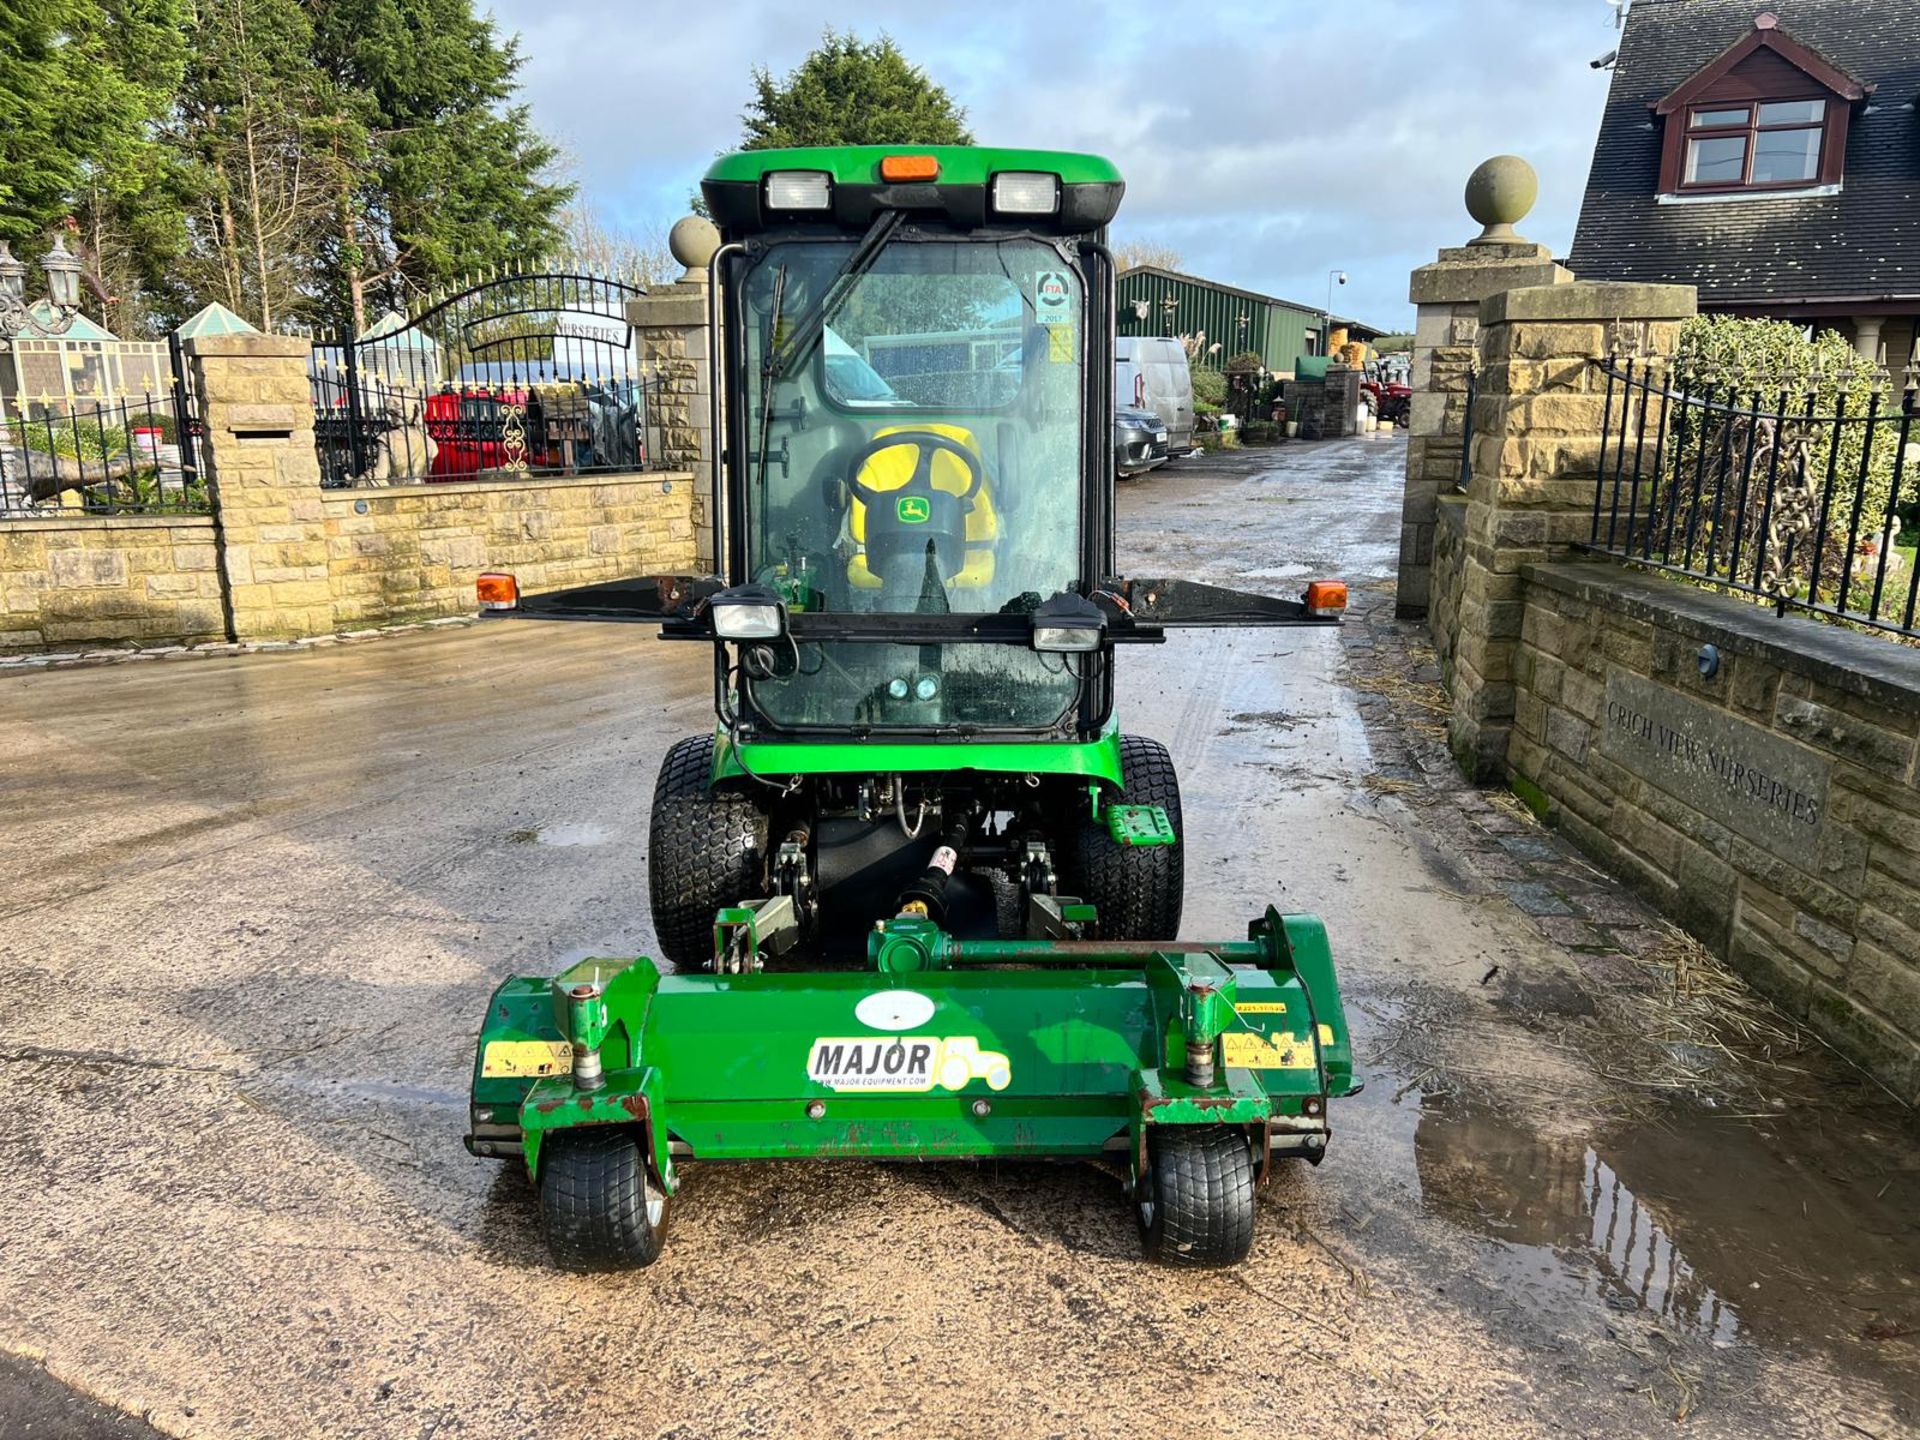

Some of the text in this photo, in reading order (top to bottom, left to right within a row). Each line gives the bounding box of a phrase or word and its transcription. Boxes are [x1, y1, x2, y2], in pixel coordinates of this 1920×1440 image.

[1045, 285, 1061, 294] FTA
[554, 316, 620, 343] NURSERIES
[1607, 700, 1819, 826] CRICH VIEW NURSERIES
[815, 1044, 931, 1075] MAJOR
